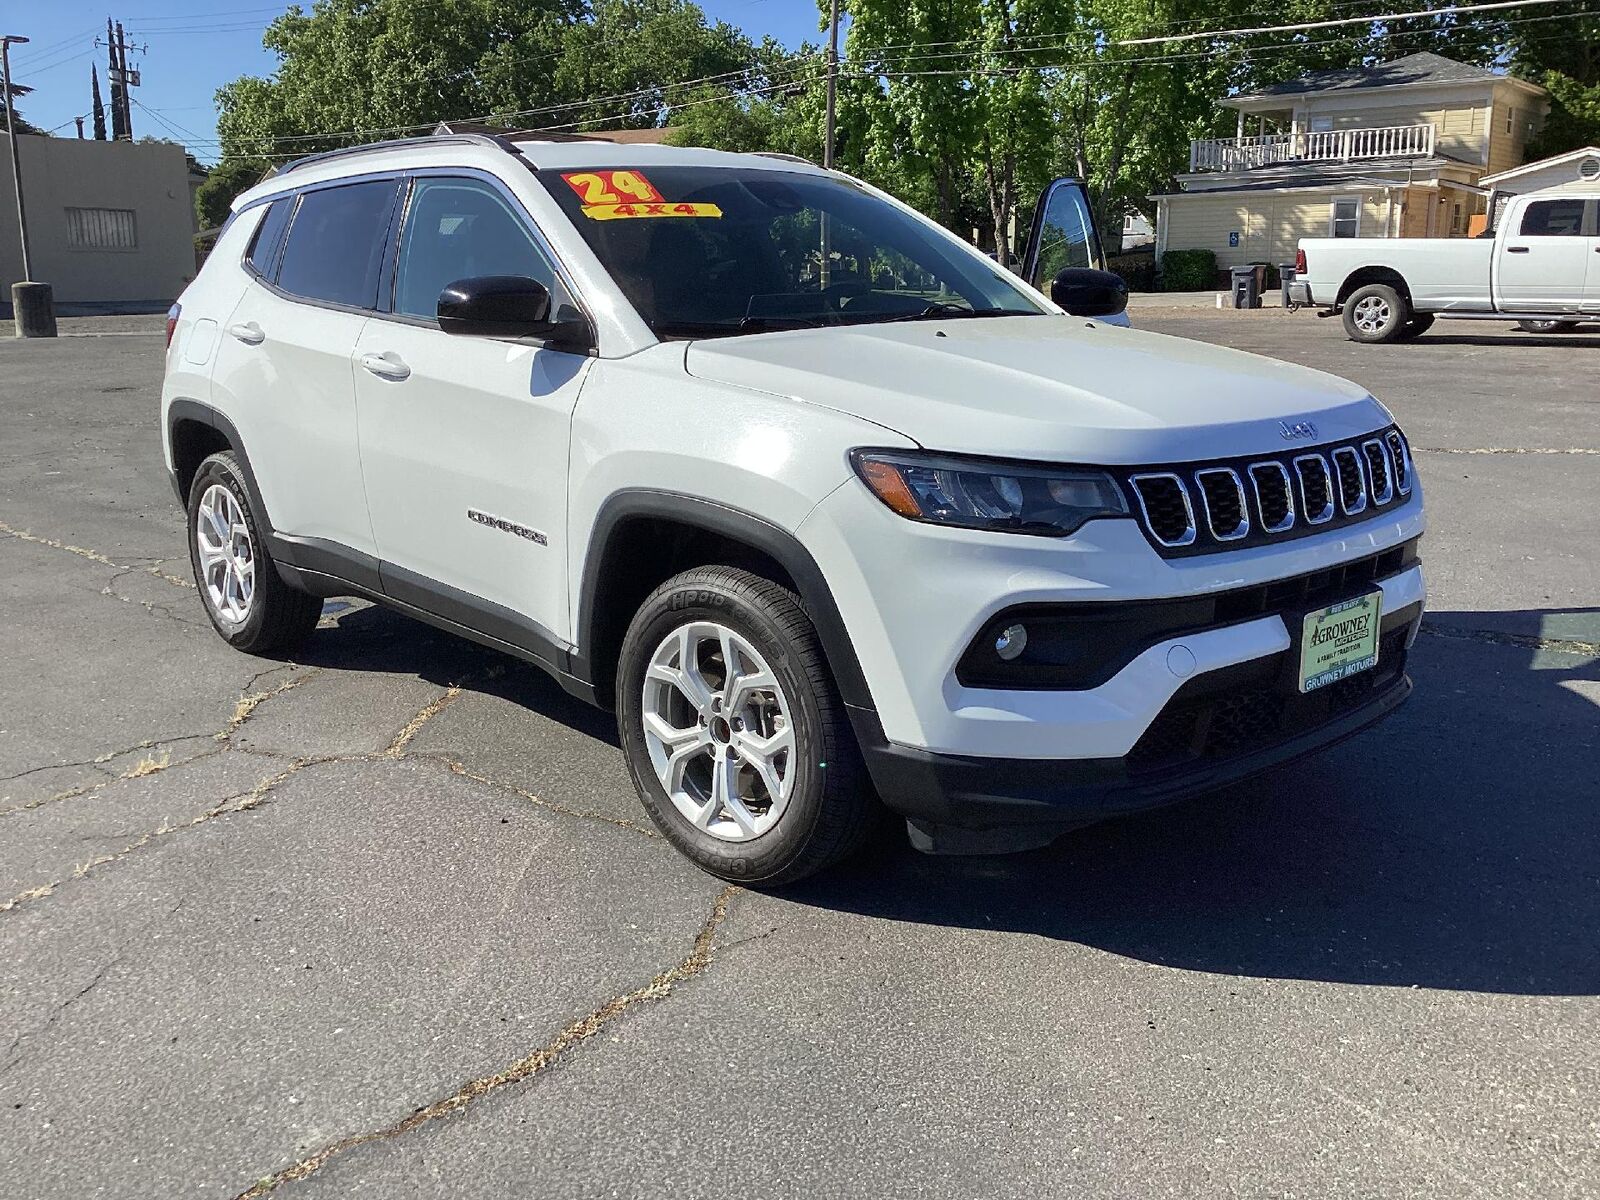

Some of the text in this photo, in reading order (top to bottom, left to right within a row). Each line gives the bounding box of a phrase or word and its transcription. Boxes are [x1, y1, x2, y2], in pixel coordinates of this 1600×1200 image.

[568, 171, 656, 203] 24
[1279, 420, 1319, 440] Jeep
[467, 509, 548, 547] COMPASS
[1306, 669, 1343, 690] GROWNEY
[1345, 657, 1375, 675] MOTORS
